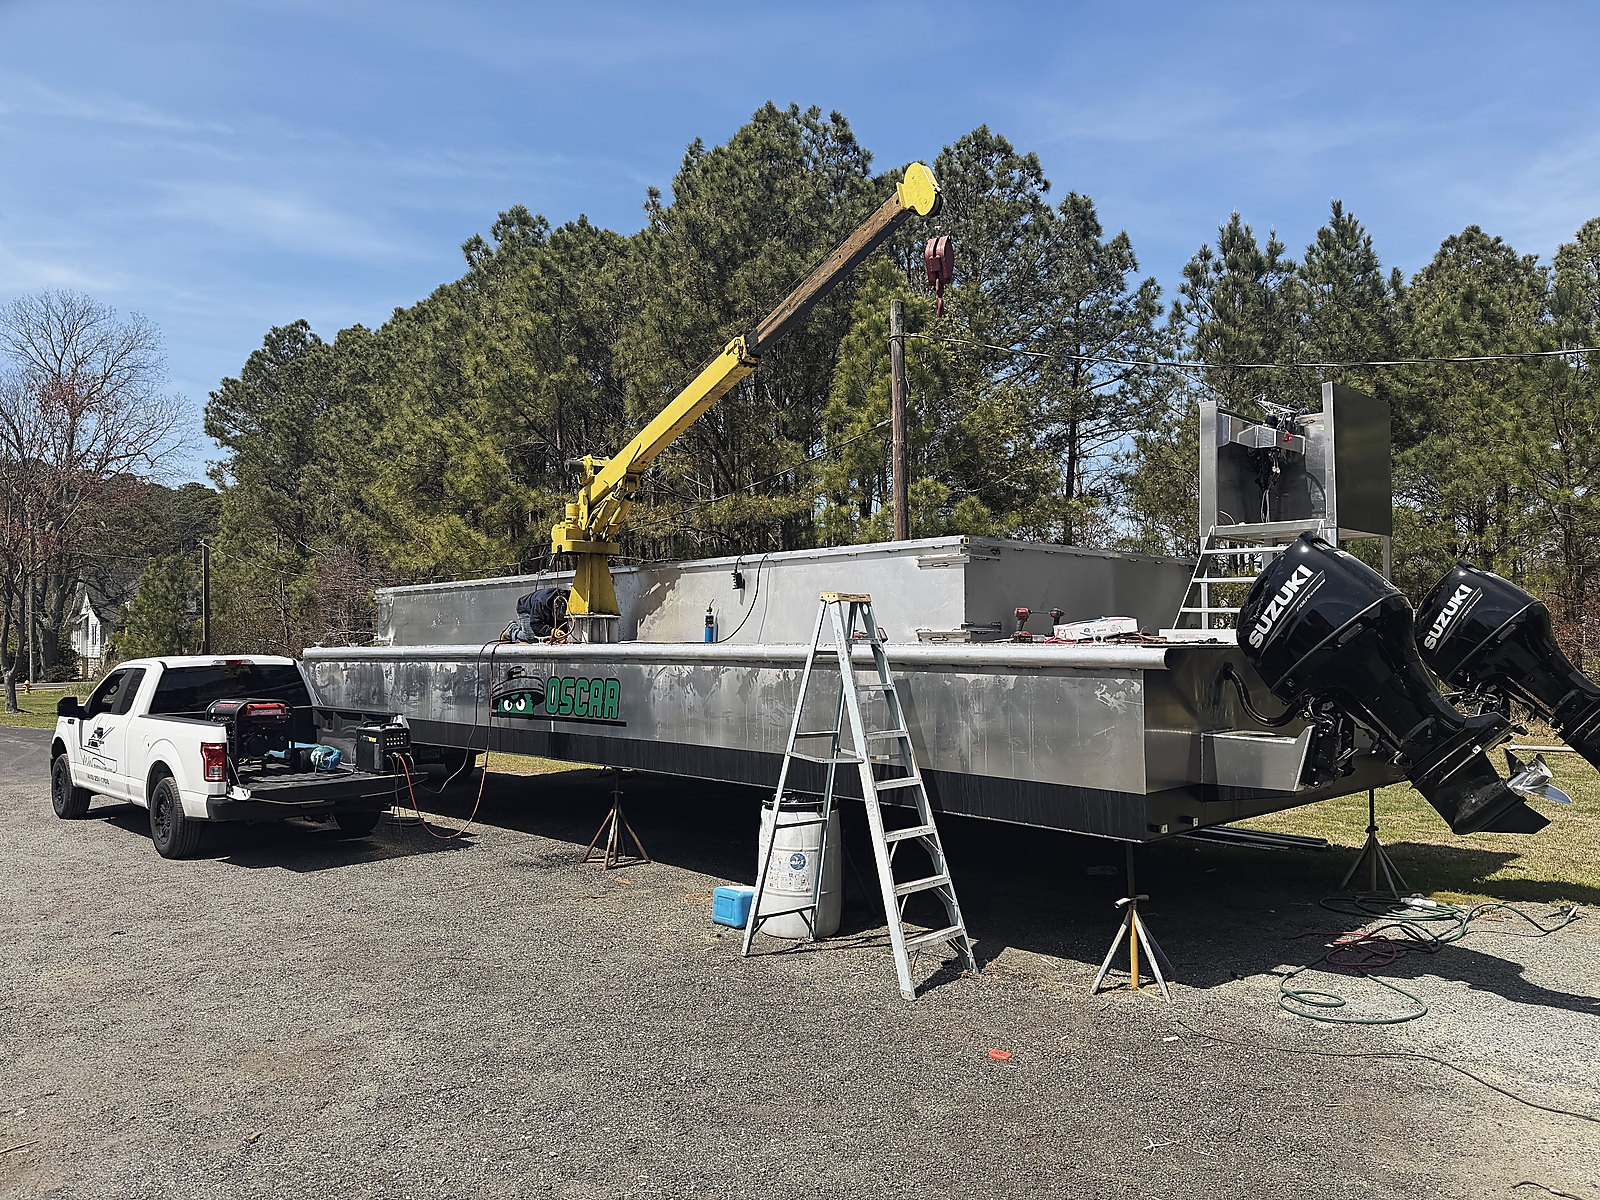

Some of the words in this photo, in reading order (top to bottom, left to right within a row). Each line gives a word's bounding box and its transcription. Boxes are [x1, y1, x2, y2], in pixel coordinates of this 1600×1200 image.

[1249, 564, 1313, 648] SUZUKI
[1424, 584, 1473, 649] SUZUKI
[545, 676, 621, 719] OSCAR
